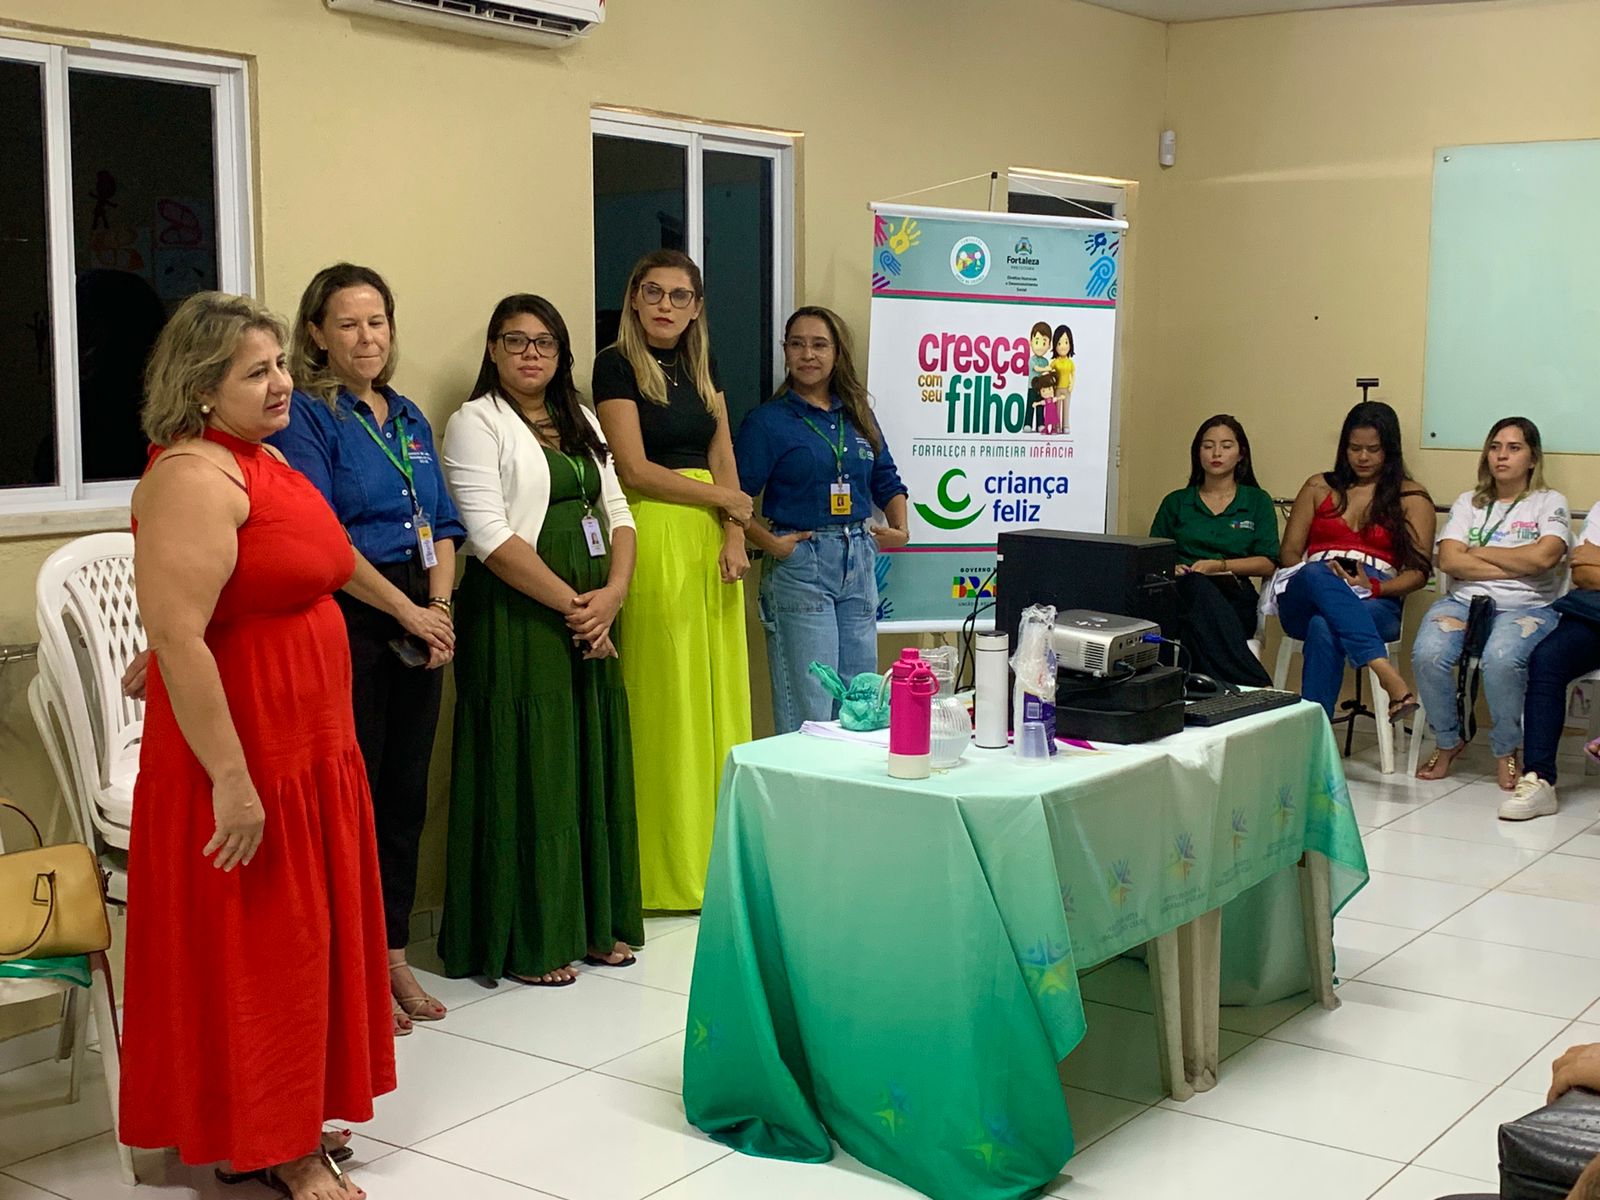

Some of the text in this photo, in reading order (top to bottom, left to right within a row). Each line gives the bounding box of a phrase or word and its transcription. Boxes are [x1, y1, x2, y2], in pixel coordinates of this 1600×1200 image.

[1007, 256, 1039, 265] Fortaleza
[918, 332, 1031, 390] cresça
[918, 374, 943, 387] com
[921, 389, 942, 403] seu
[945, 374, 1025, 435] filho
[912, 442, 1074, 458] FORTALEÇA A PRIMEIRA INFÂNCIA
[984, 470, 1069, 499] criança
[993, 499, 1041, 522] feliz
